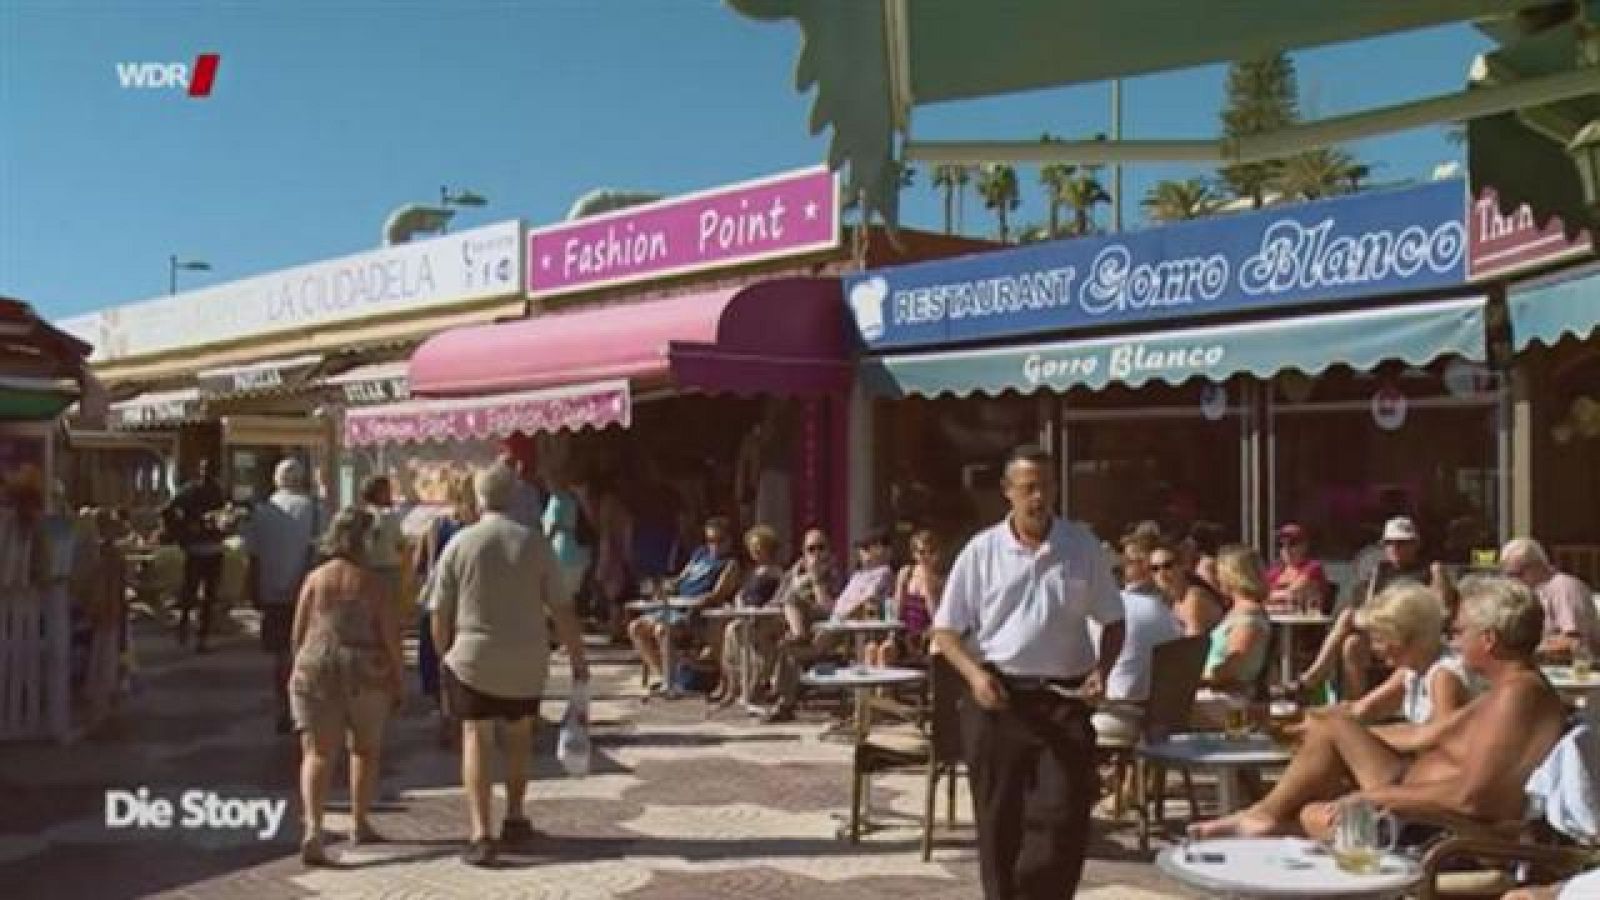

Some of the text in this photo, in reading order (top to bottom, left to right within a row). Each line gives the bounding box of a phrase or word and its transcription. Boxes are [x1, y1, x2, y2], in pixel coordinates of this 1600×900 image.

[563, 228, 668, 280] Fashion
[699, 199, 786, 249] Point
[894, 217, 1464, 326] RESTAURANT Gorro Blanco
[300, 254, 437, 313] CIUDADELA
[1023, 344, 1224, 384] Gorro Blanco
